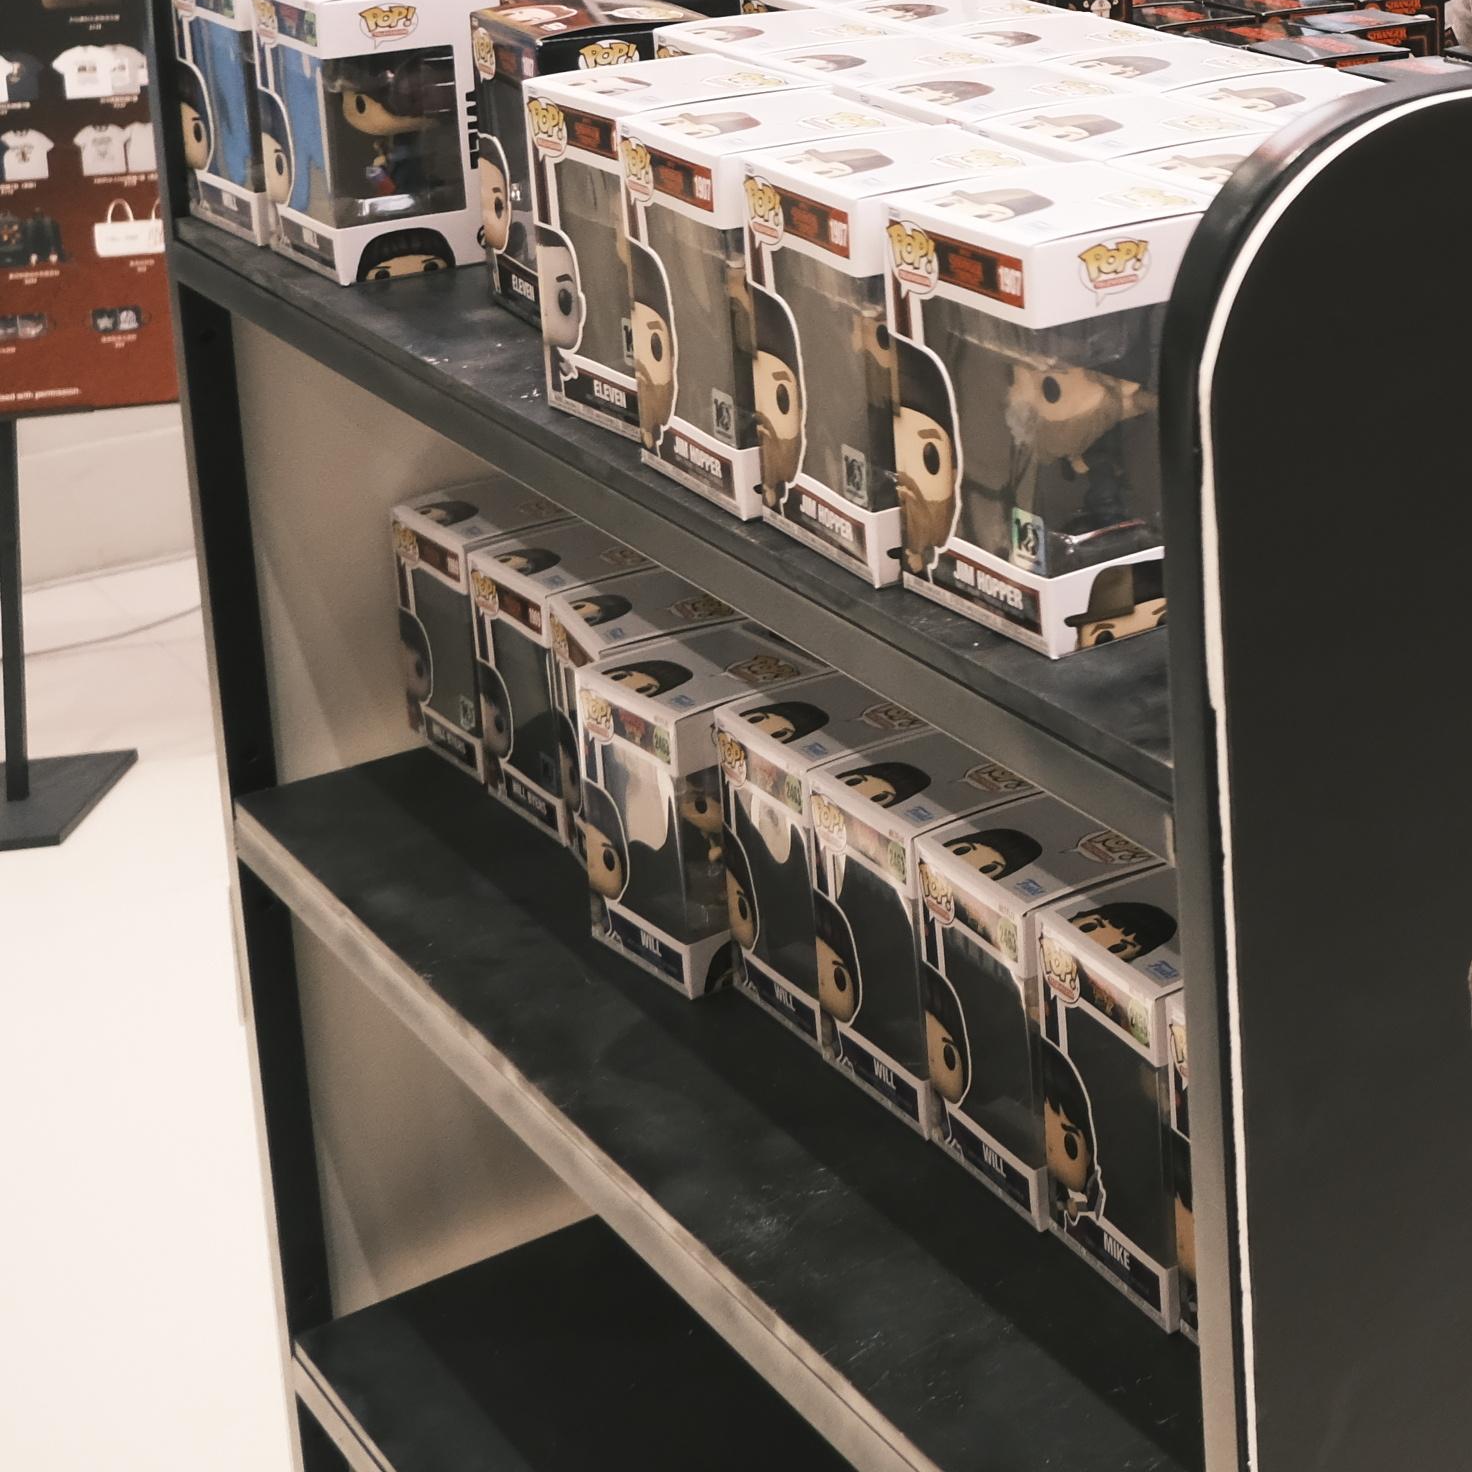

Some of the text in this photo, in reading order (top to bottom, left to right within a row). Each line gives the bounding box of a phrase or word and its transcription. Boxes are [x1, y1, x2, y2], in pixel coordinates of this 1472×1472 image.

[359, 5, 417, 29] POP!
[579, 43, 637, 68] POP!
[887, 223, 936, 273] POP!
[1079, 240, 1149, 278] POP!
[511, 273, 536, 301] ELEVEN
[592, 378, 628, 409] ELEVEN
[673, 435, 722, 479] JIM HOPPER
[800, 493, 853, 542] JIM HOPPER
[953, 558, 1023, 611] JIM HOPPER
[812, 792, 846, 836] POP!
[920, 862, 954, 910] POP!
[640, 929, 663, 958] WILL
[1041, 935, 1079, 991] POP!
[774, 982, 797, 1012] WILL
[872, 1057, 898, 1091] WILL
[981, 1142, 1008, 1178] WILL
[1103, 1230, 1132, 1272] MIKE
